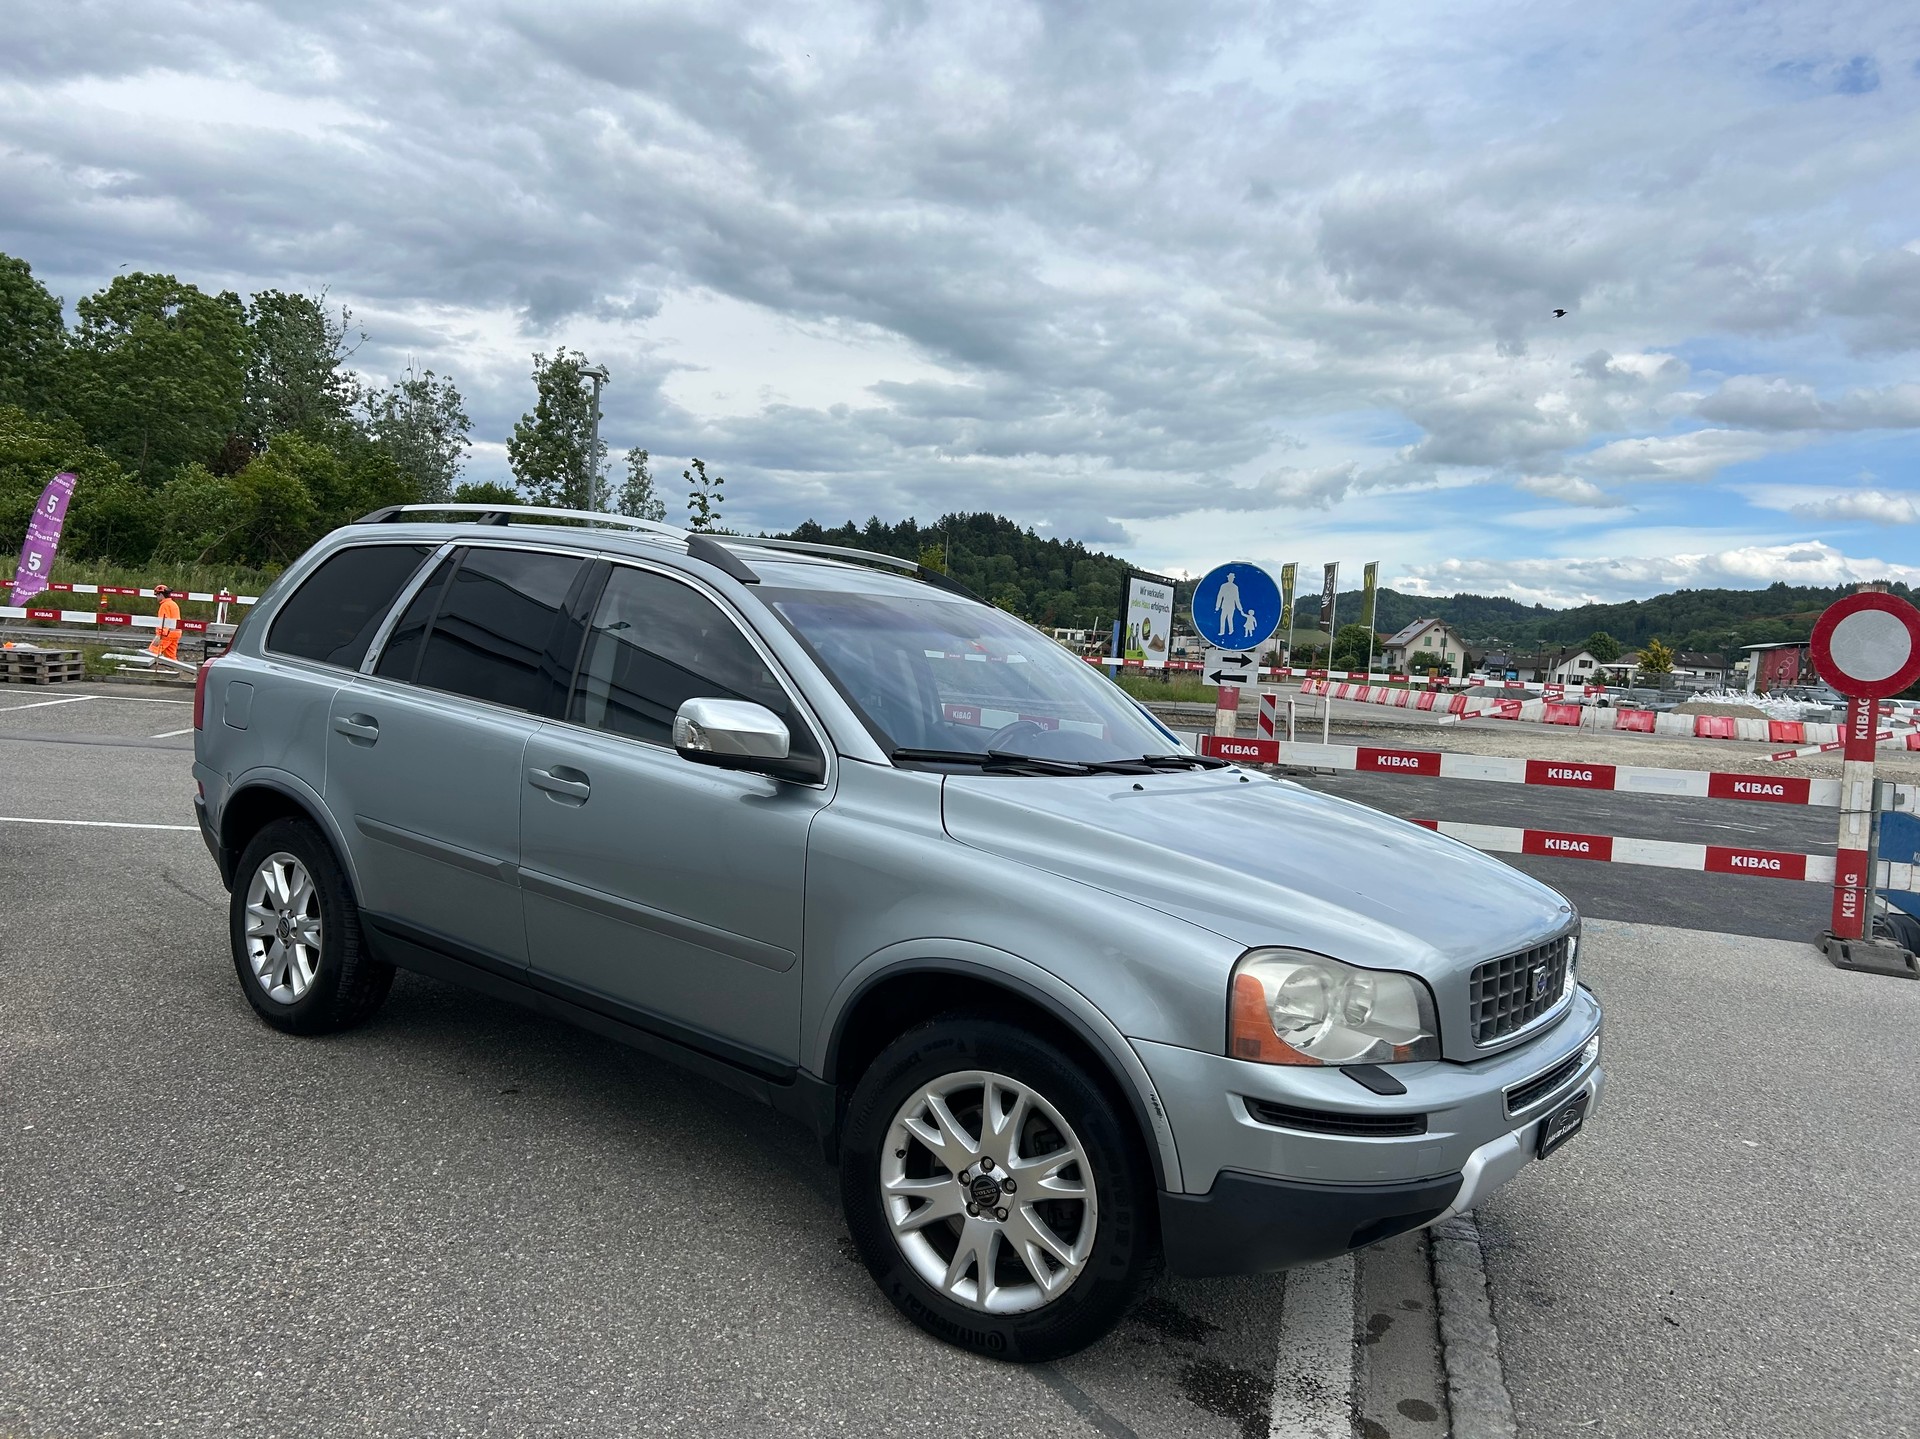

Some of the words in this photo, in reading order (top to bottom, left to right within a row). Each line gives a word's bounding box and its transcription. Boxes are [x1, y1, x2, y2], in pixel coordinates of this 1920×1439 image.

[47, 495, 59, 514] 5
[28, 552, 42, 571] 5
[952, 710, 972, 720] KIBAG
[1855, 698, 1870, 740] KIBAG
[1221, 744, 1259, 756] KIBAG
[1377, 755, 1419, 768] KIBAG
[1547, 768, 1593, 781] KIBAG
[1734, 782, 1784, 796] KIBAG
[1544, 838, 1590, 852] KIBAG
[1731, 855, 1781, 871] KIBAG
[1842, 873, 1858, 918] KIBAG
[974, 1188, 996, 1196] VOLVO
